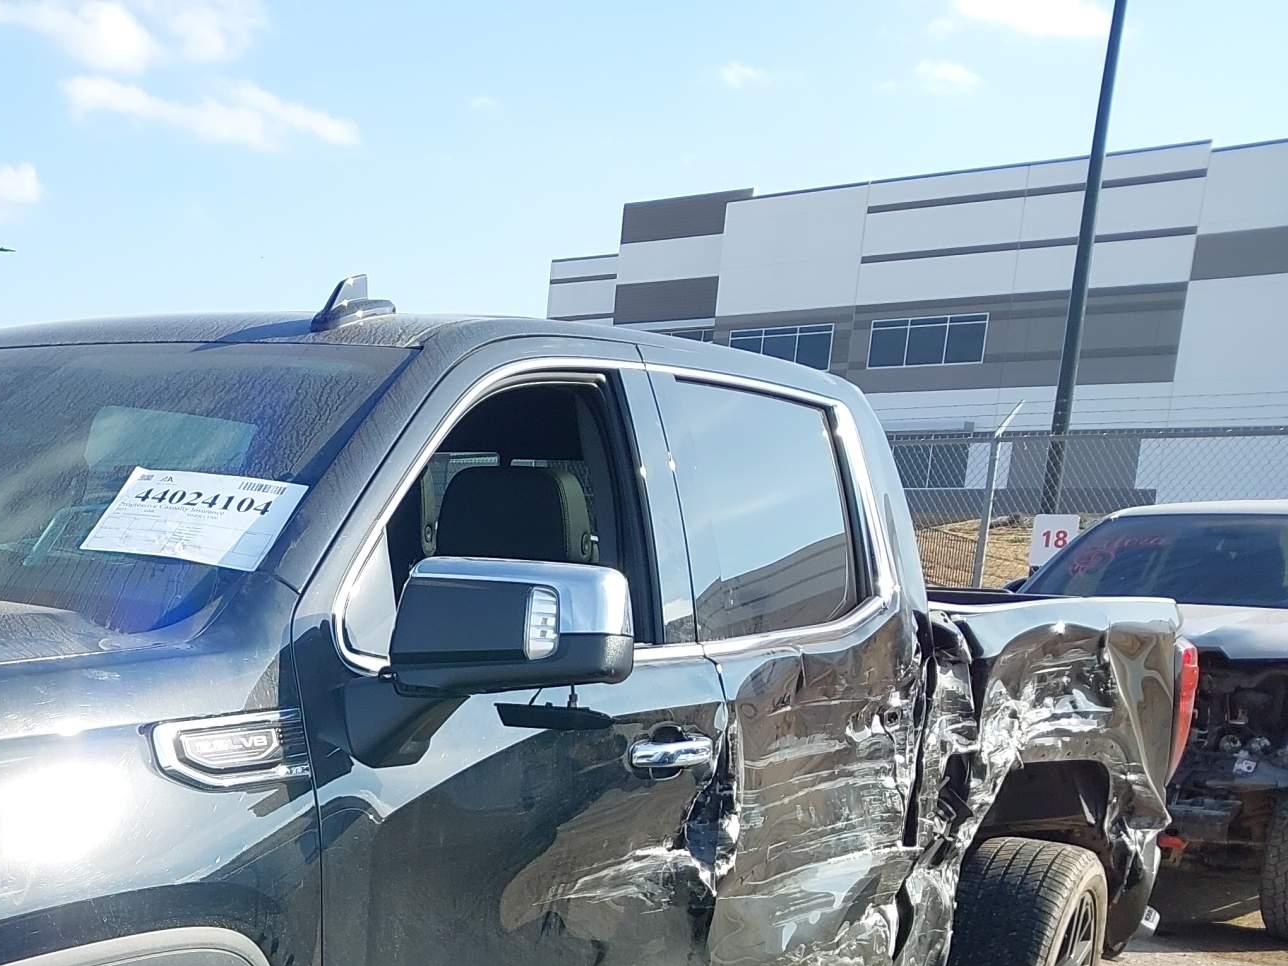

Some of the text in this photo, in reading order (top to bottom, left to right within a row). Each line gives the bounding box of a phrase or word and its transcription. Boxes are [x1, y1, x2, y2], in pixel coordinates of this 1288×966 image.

[135, 488, 273, 516] 44024104
[1041, 529, 1068, 549] 18
[240, 735, 268, 748] V8
